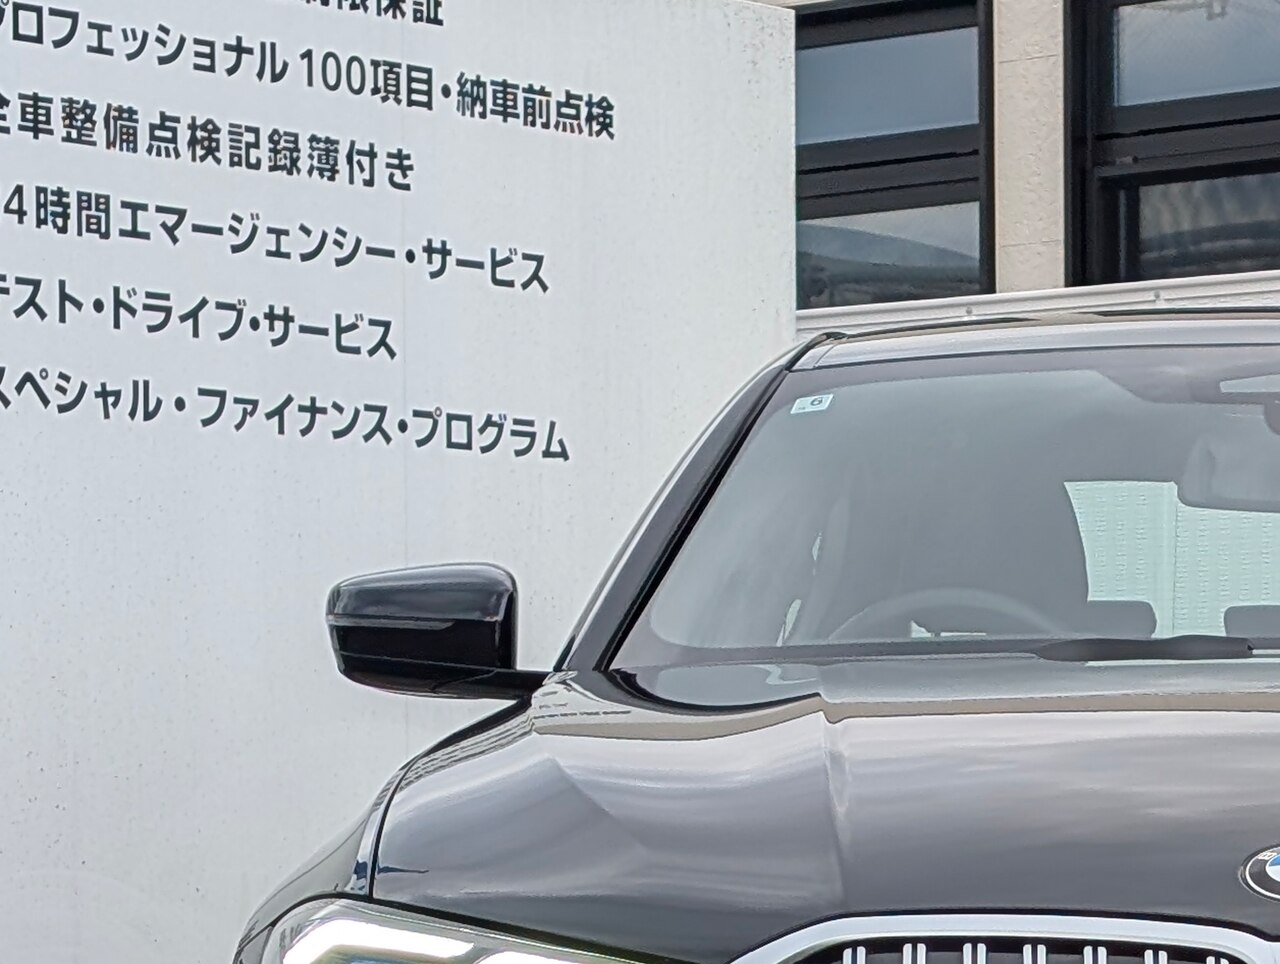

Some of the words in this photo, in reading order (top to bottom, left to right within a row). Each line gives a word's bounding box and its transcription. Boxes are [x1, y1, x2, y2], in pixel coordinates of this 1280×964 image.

[0, 92, 413, 191] 車整備点検記録簿付き
